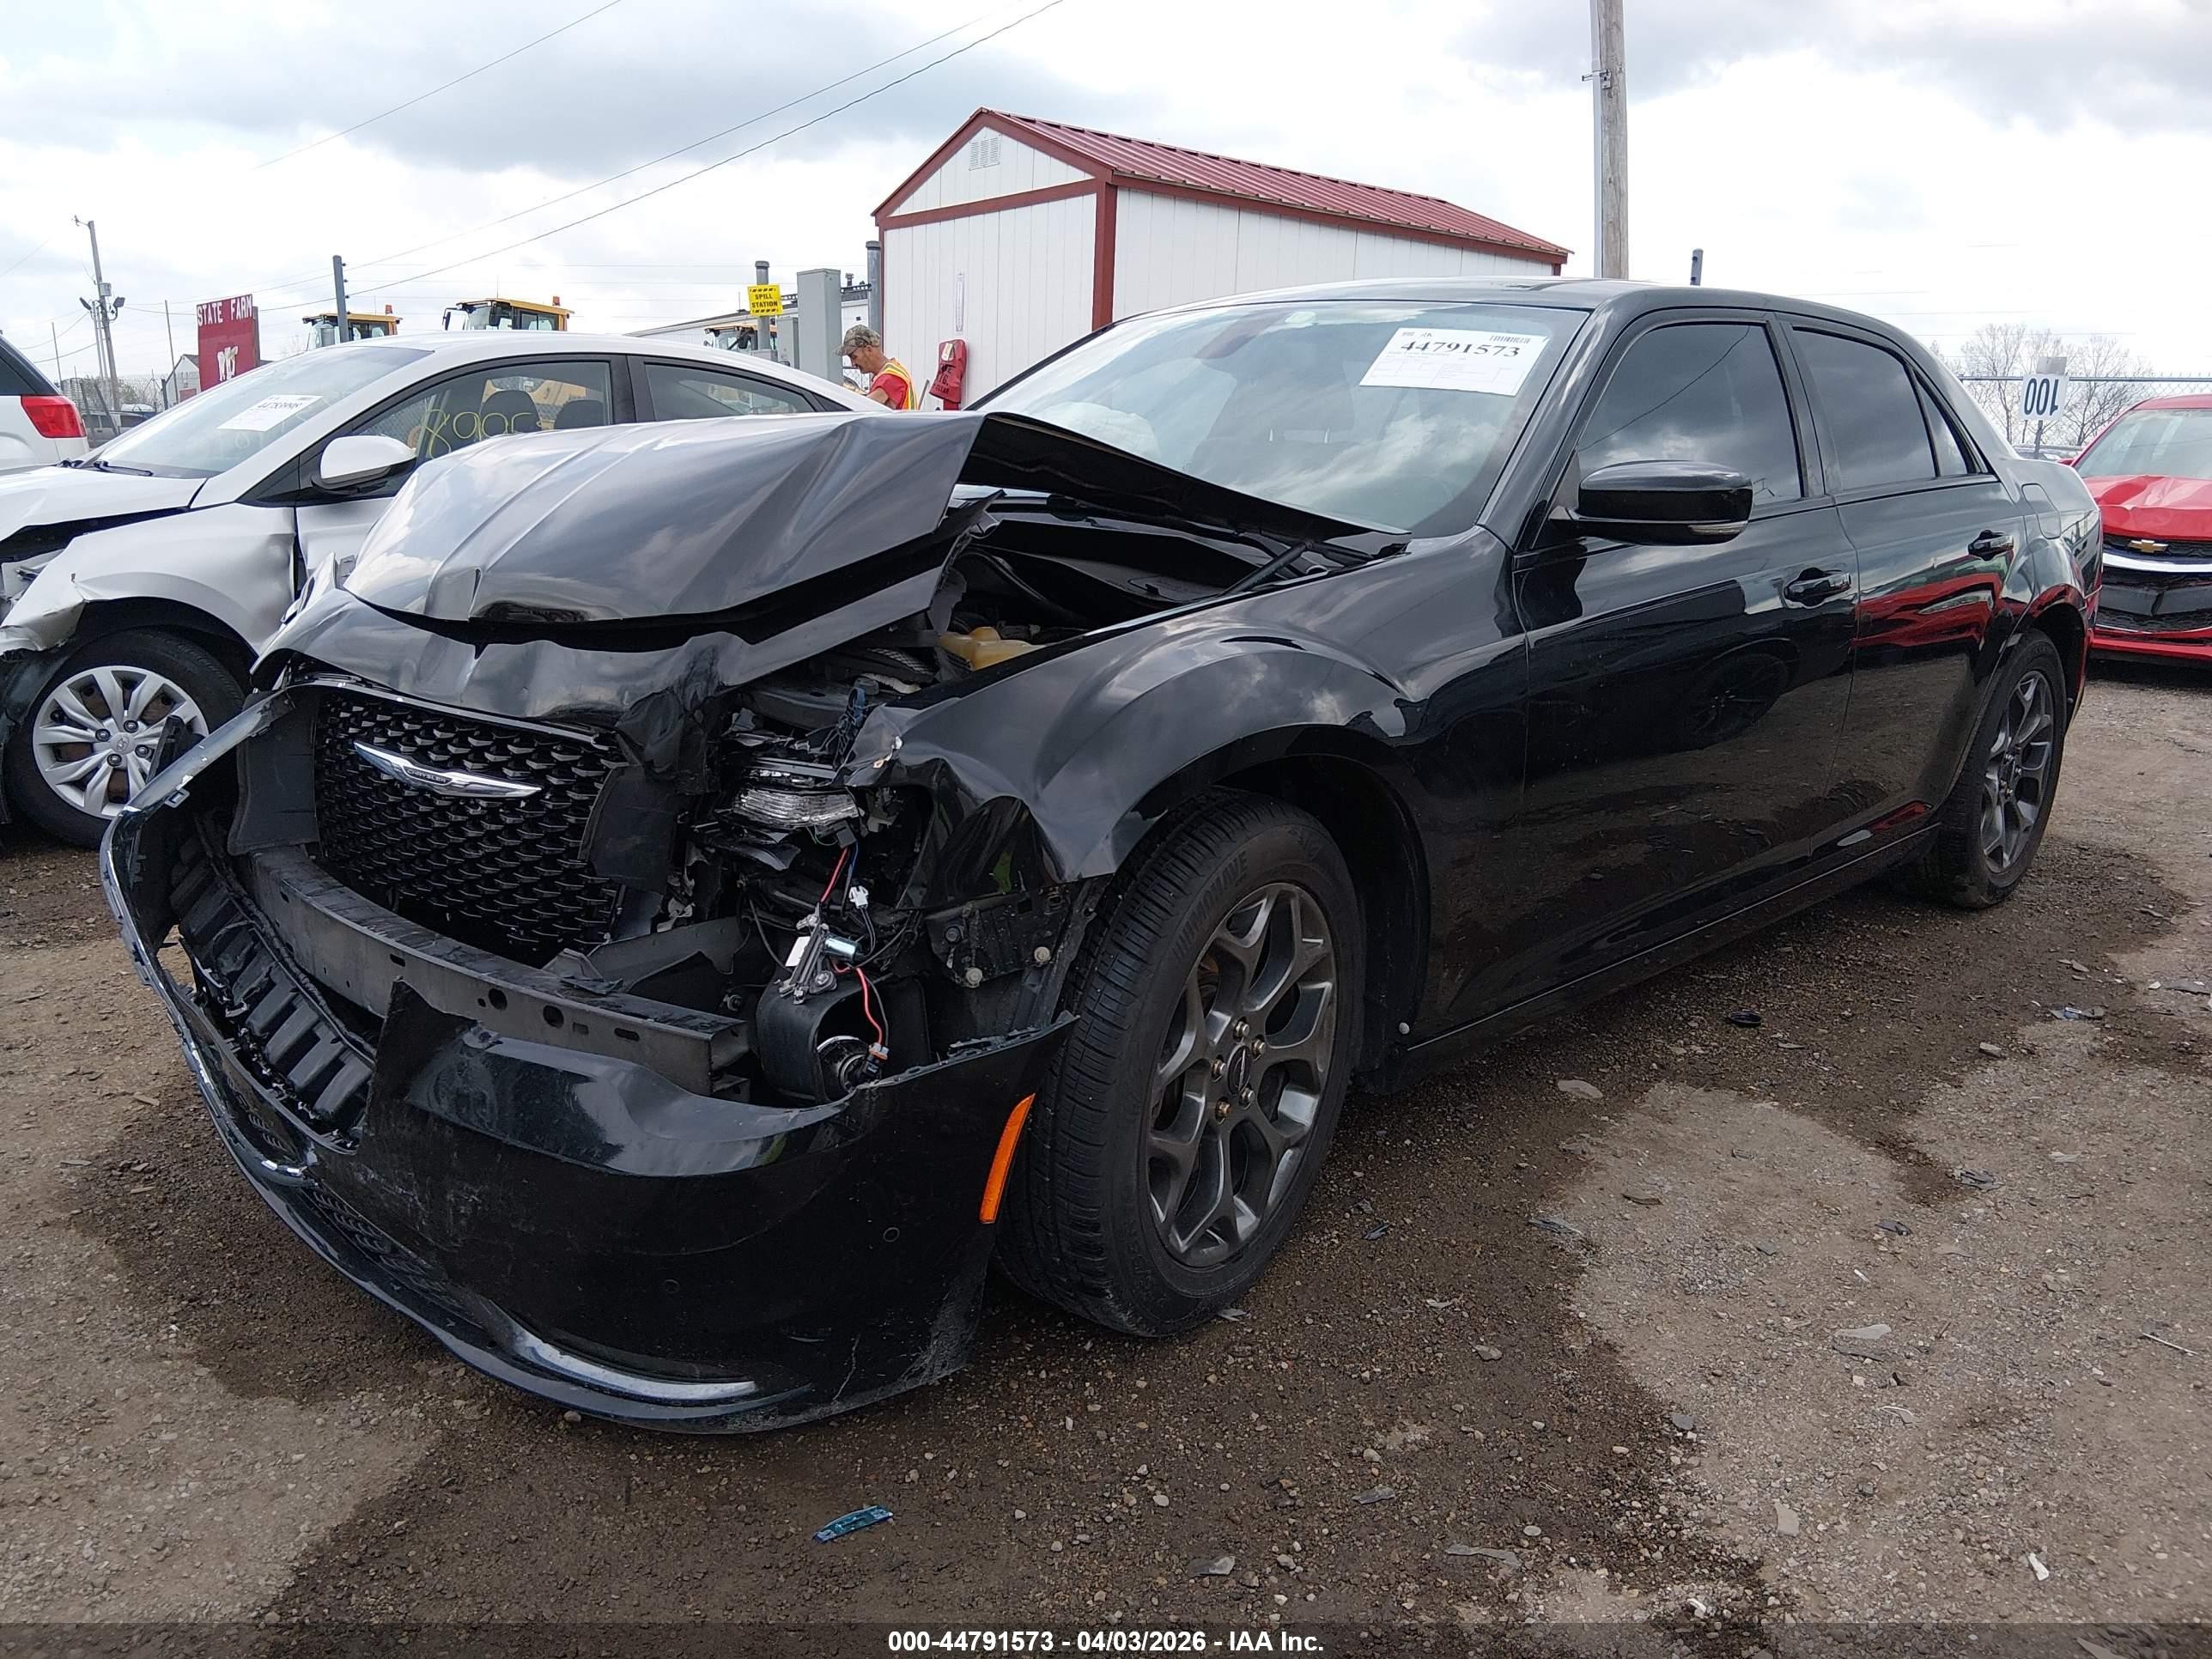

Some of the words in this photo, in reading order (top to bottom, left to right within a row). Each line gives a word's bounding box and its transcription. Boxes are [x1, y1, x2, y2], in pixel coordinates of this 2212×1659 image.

[197, 301, 223, 326] STATE
[230, 295, 252, 320] FARM
[1401, 341, 1521, 357] 44791573
[407, 769, 447, 783] CHRYSLER
